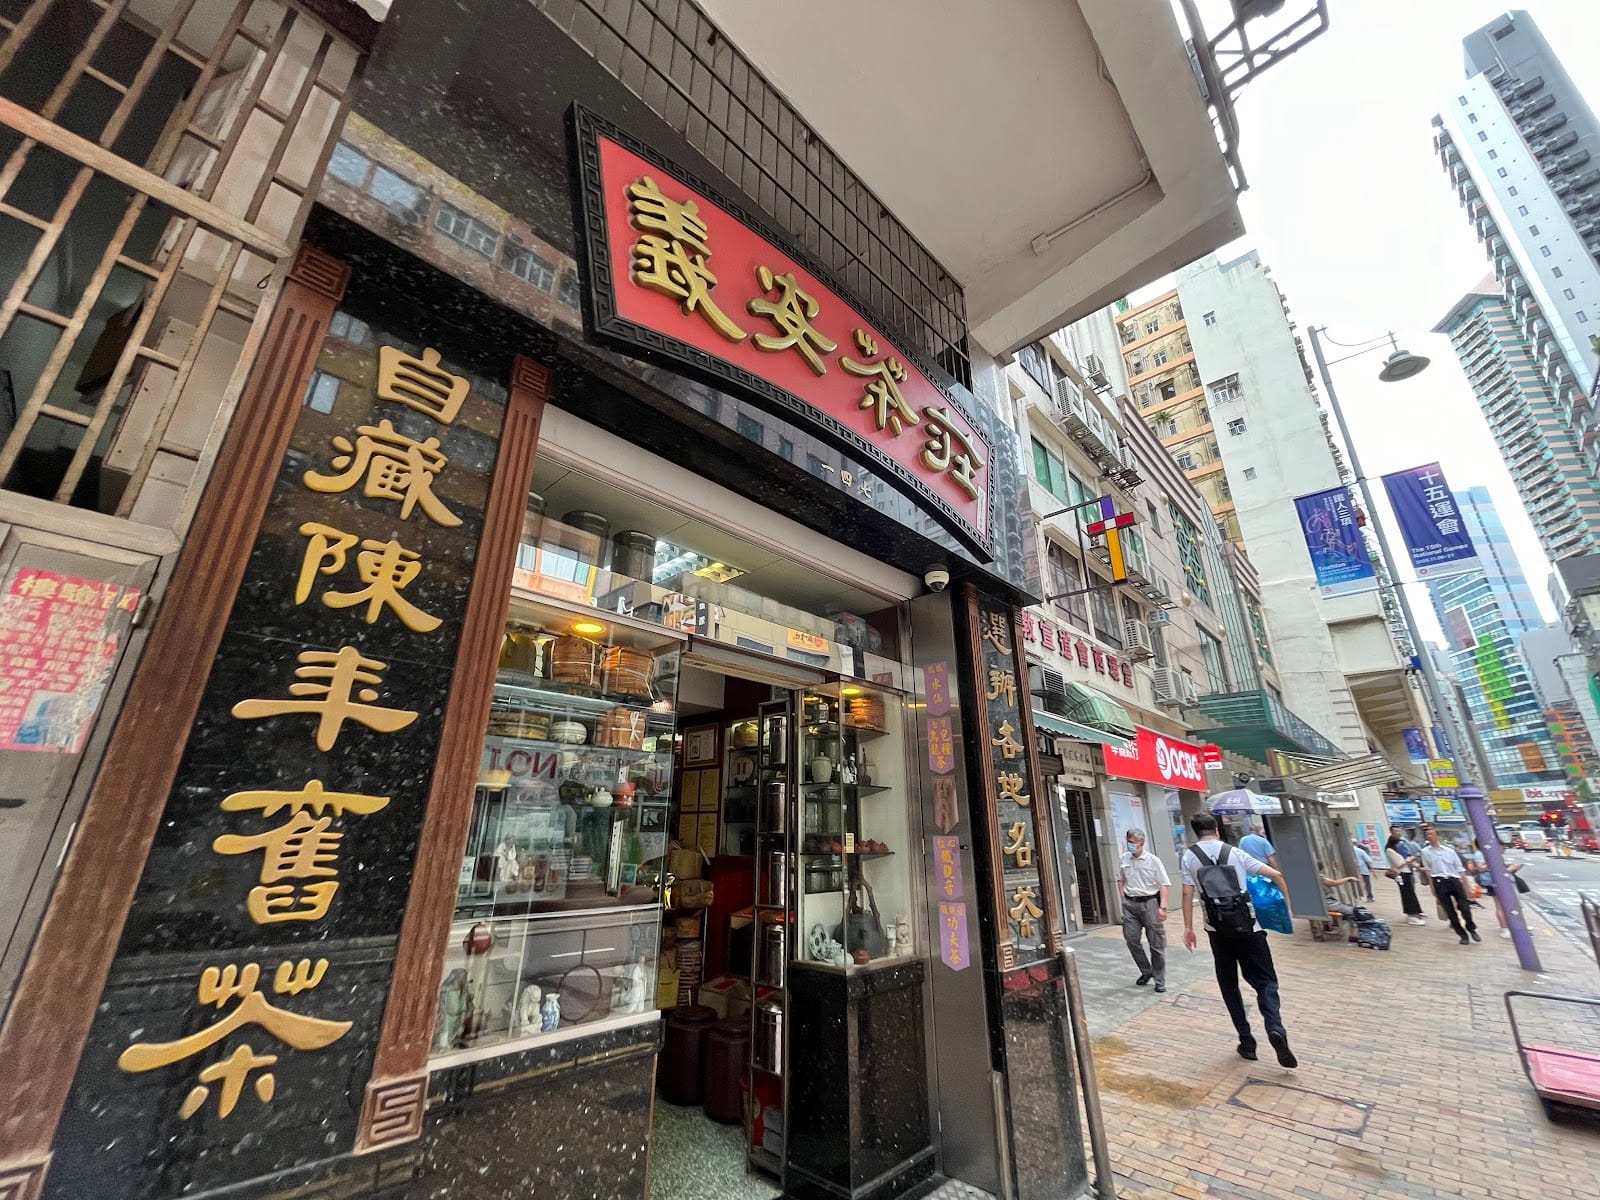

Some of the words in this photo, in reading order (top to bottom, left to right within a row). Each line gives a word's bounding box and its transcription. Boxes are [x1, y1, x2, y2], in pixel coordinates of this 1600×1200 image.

[821, 463, 872, 499] 一四七
[1419, 471, 1460, 536] 十五運會
[1169, 747, 1202, 781] OCBC
